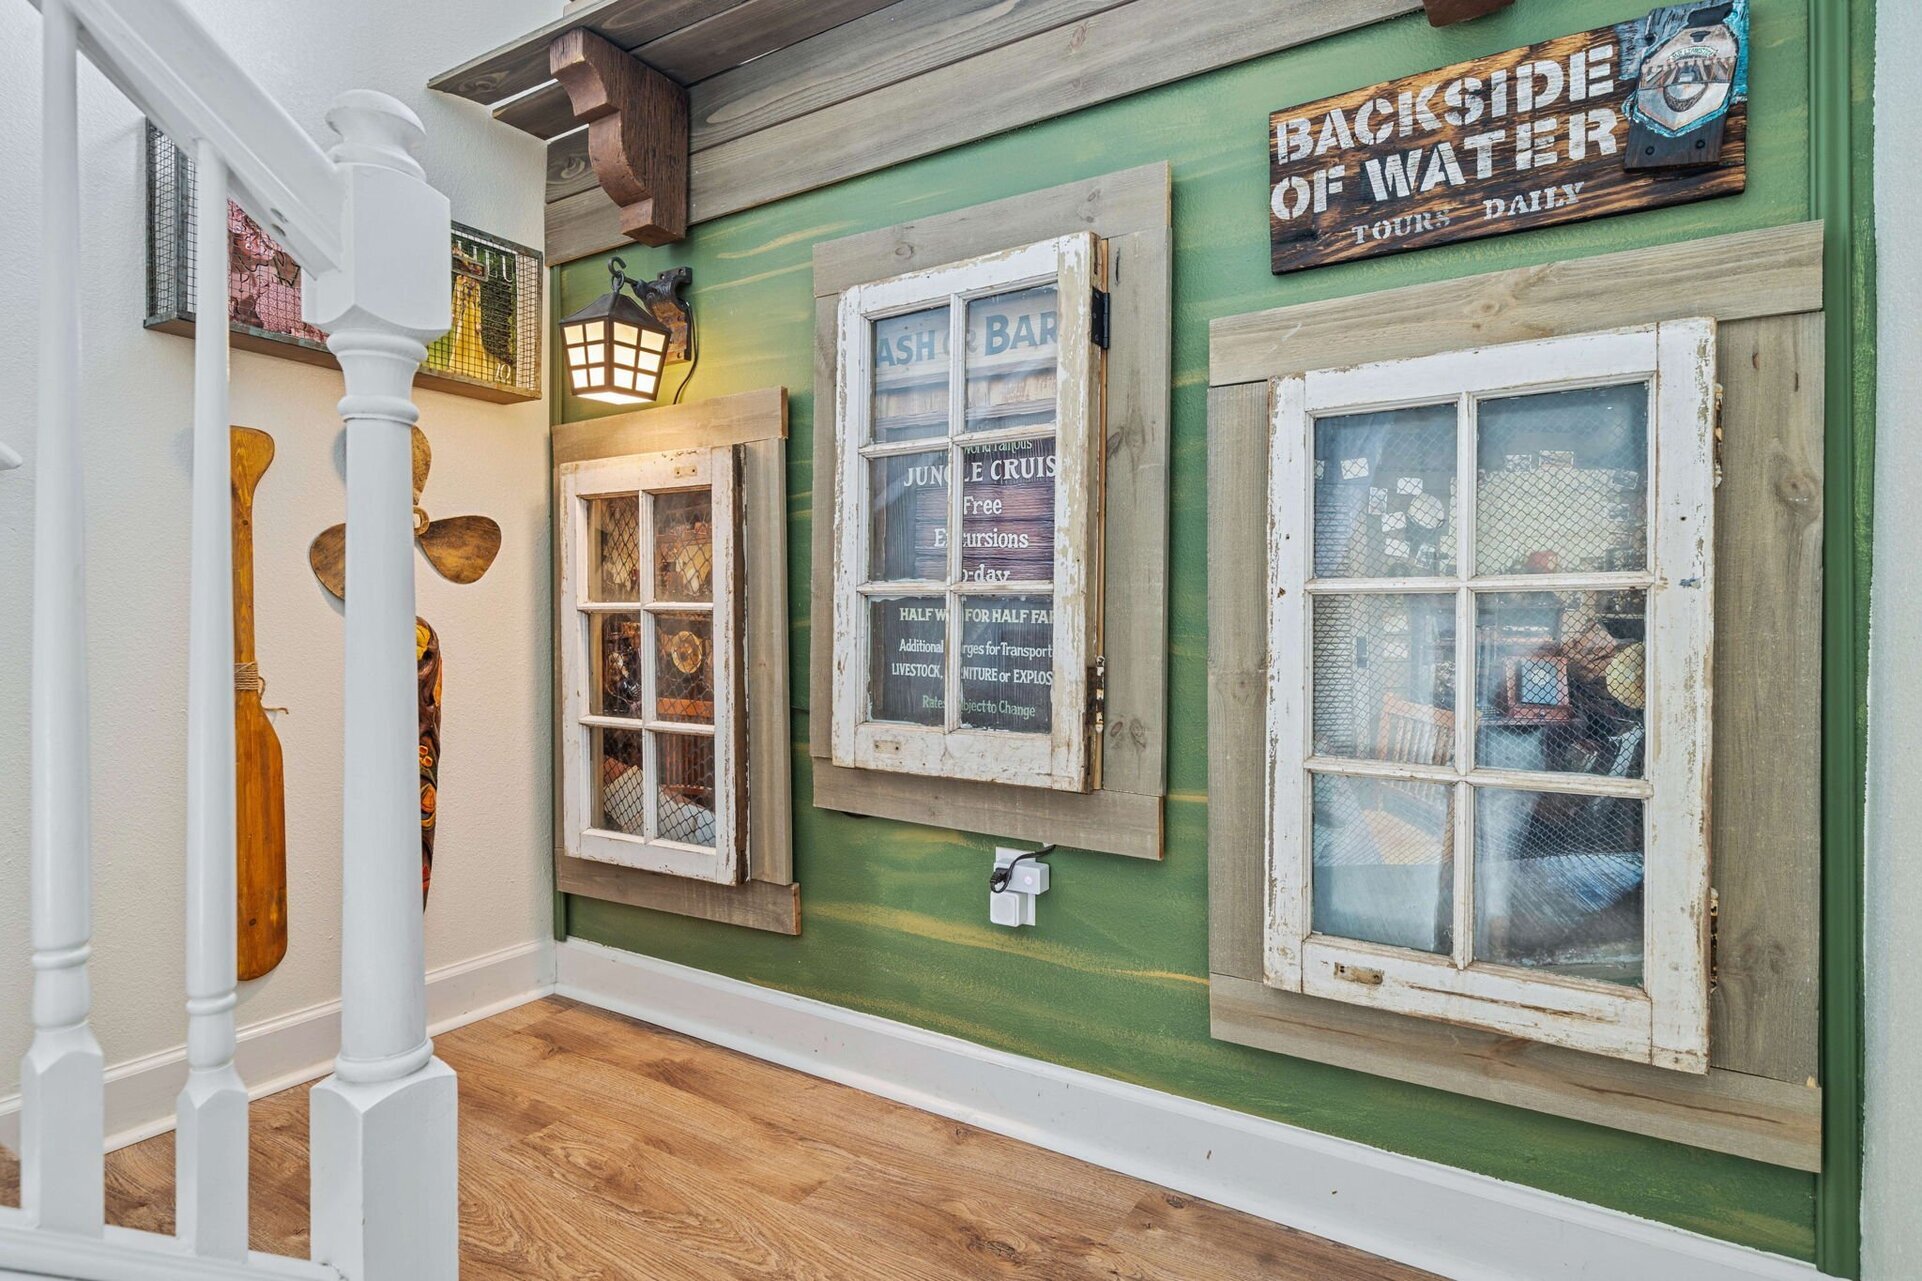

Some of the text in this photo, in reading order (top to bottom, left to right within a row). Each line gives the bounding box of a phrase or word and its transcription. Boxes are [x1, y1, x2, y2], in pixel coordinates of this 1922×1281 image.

[1275, 44, 1615, 165] BACKSIDE
[1271, 109, 1618, 220] OF WATER
[1352, 182, 1584, 245] TOURS DAILY
[963, 496, 1002, 515] Free
[934, 528, 1029, 549] Eursions
[899, 608, 933, 621] HALF
[964, 609, 990, 622] FOR
[992, 609, 1029, 623] HALF
[899, 639, 1052, 661] Additional rges for Transport
[891, 663, 1052, 685] LIVESTOCK, NITURE or EXPLOS
[999, 701, 1036, 720] Change
